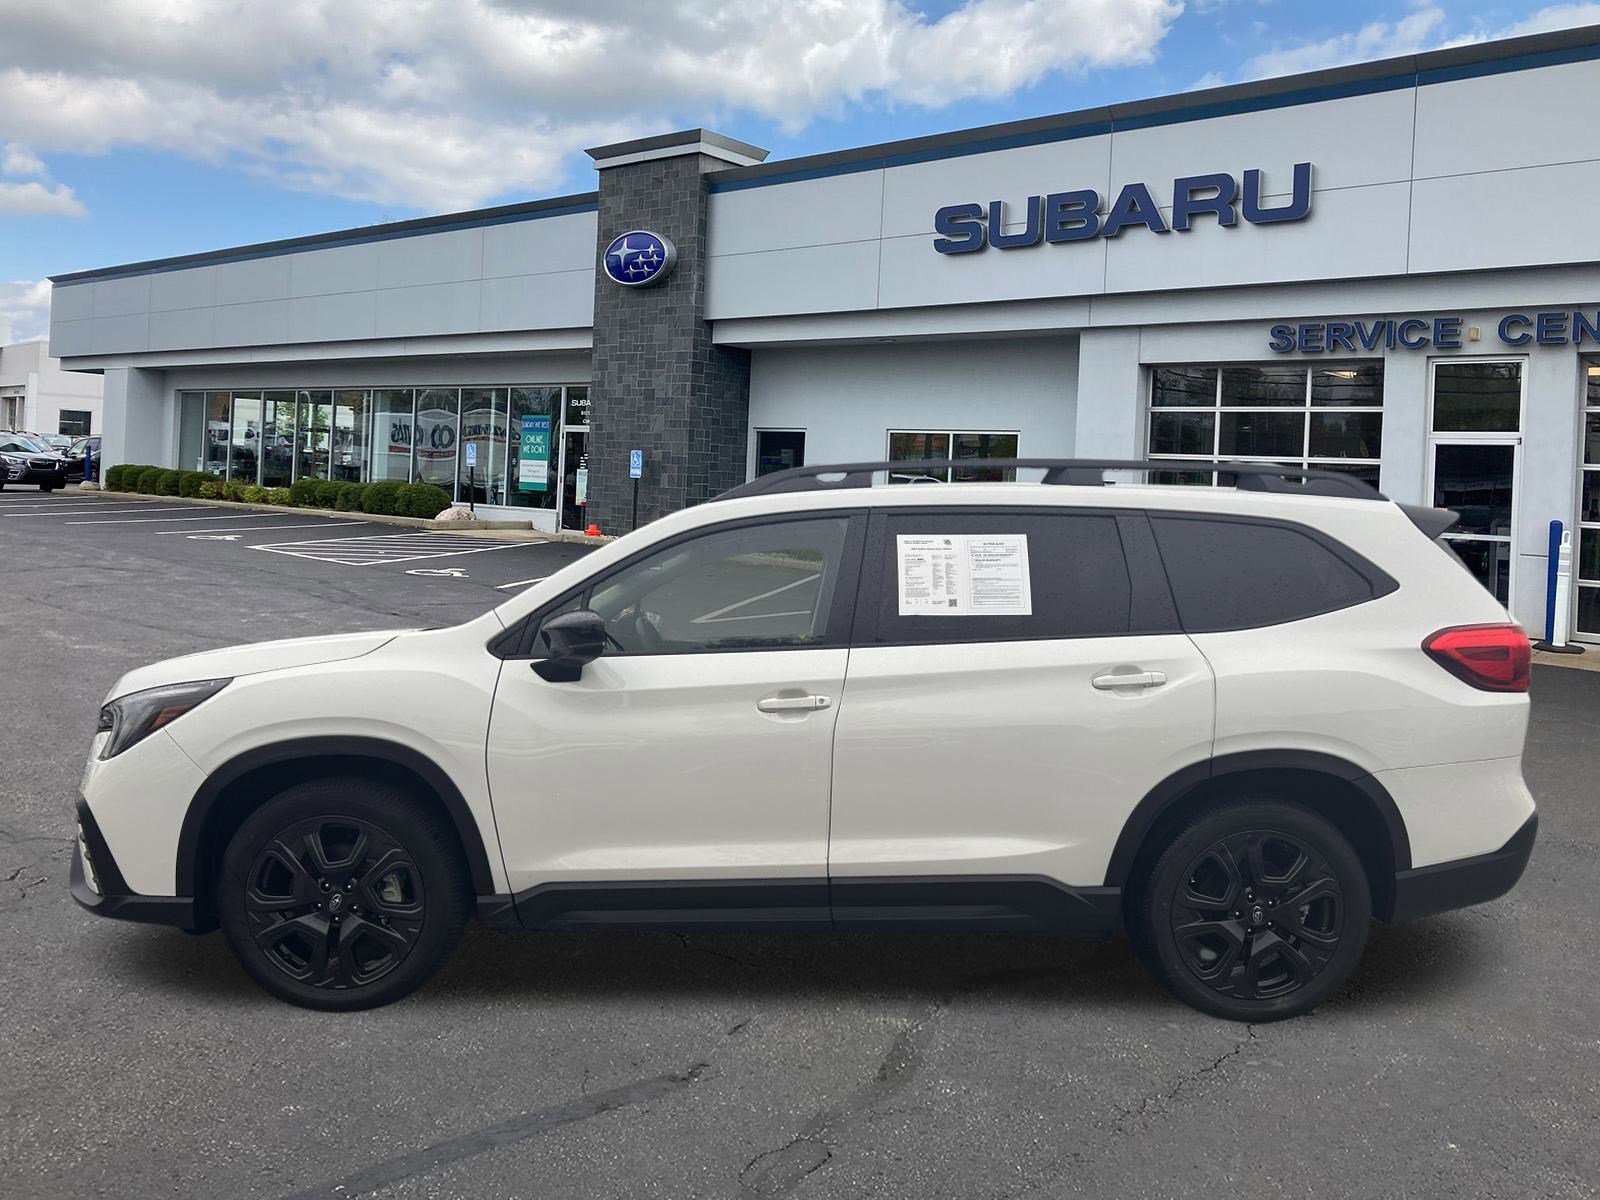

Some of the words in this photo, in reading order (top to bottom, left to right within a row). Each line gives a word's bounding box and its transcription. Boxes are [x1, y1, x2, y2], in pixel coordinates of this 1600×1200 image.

[933, 161, 1313, 256] SUBARU
[1268, 317, 1463, 353] SERVICE
[1497, 310, 1600, 346] CEN
